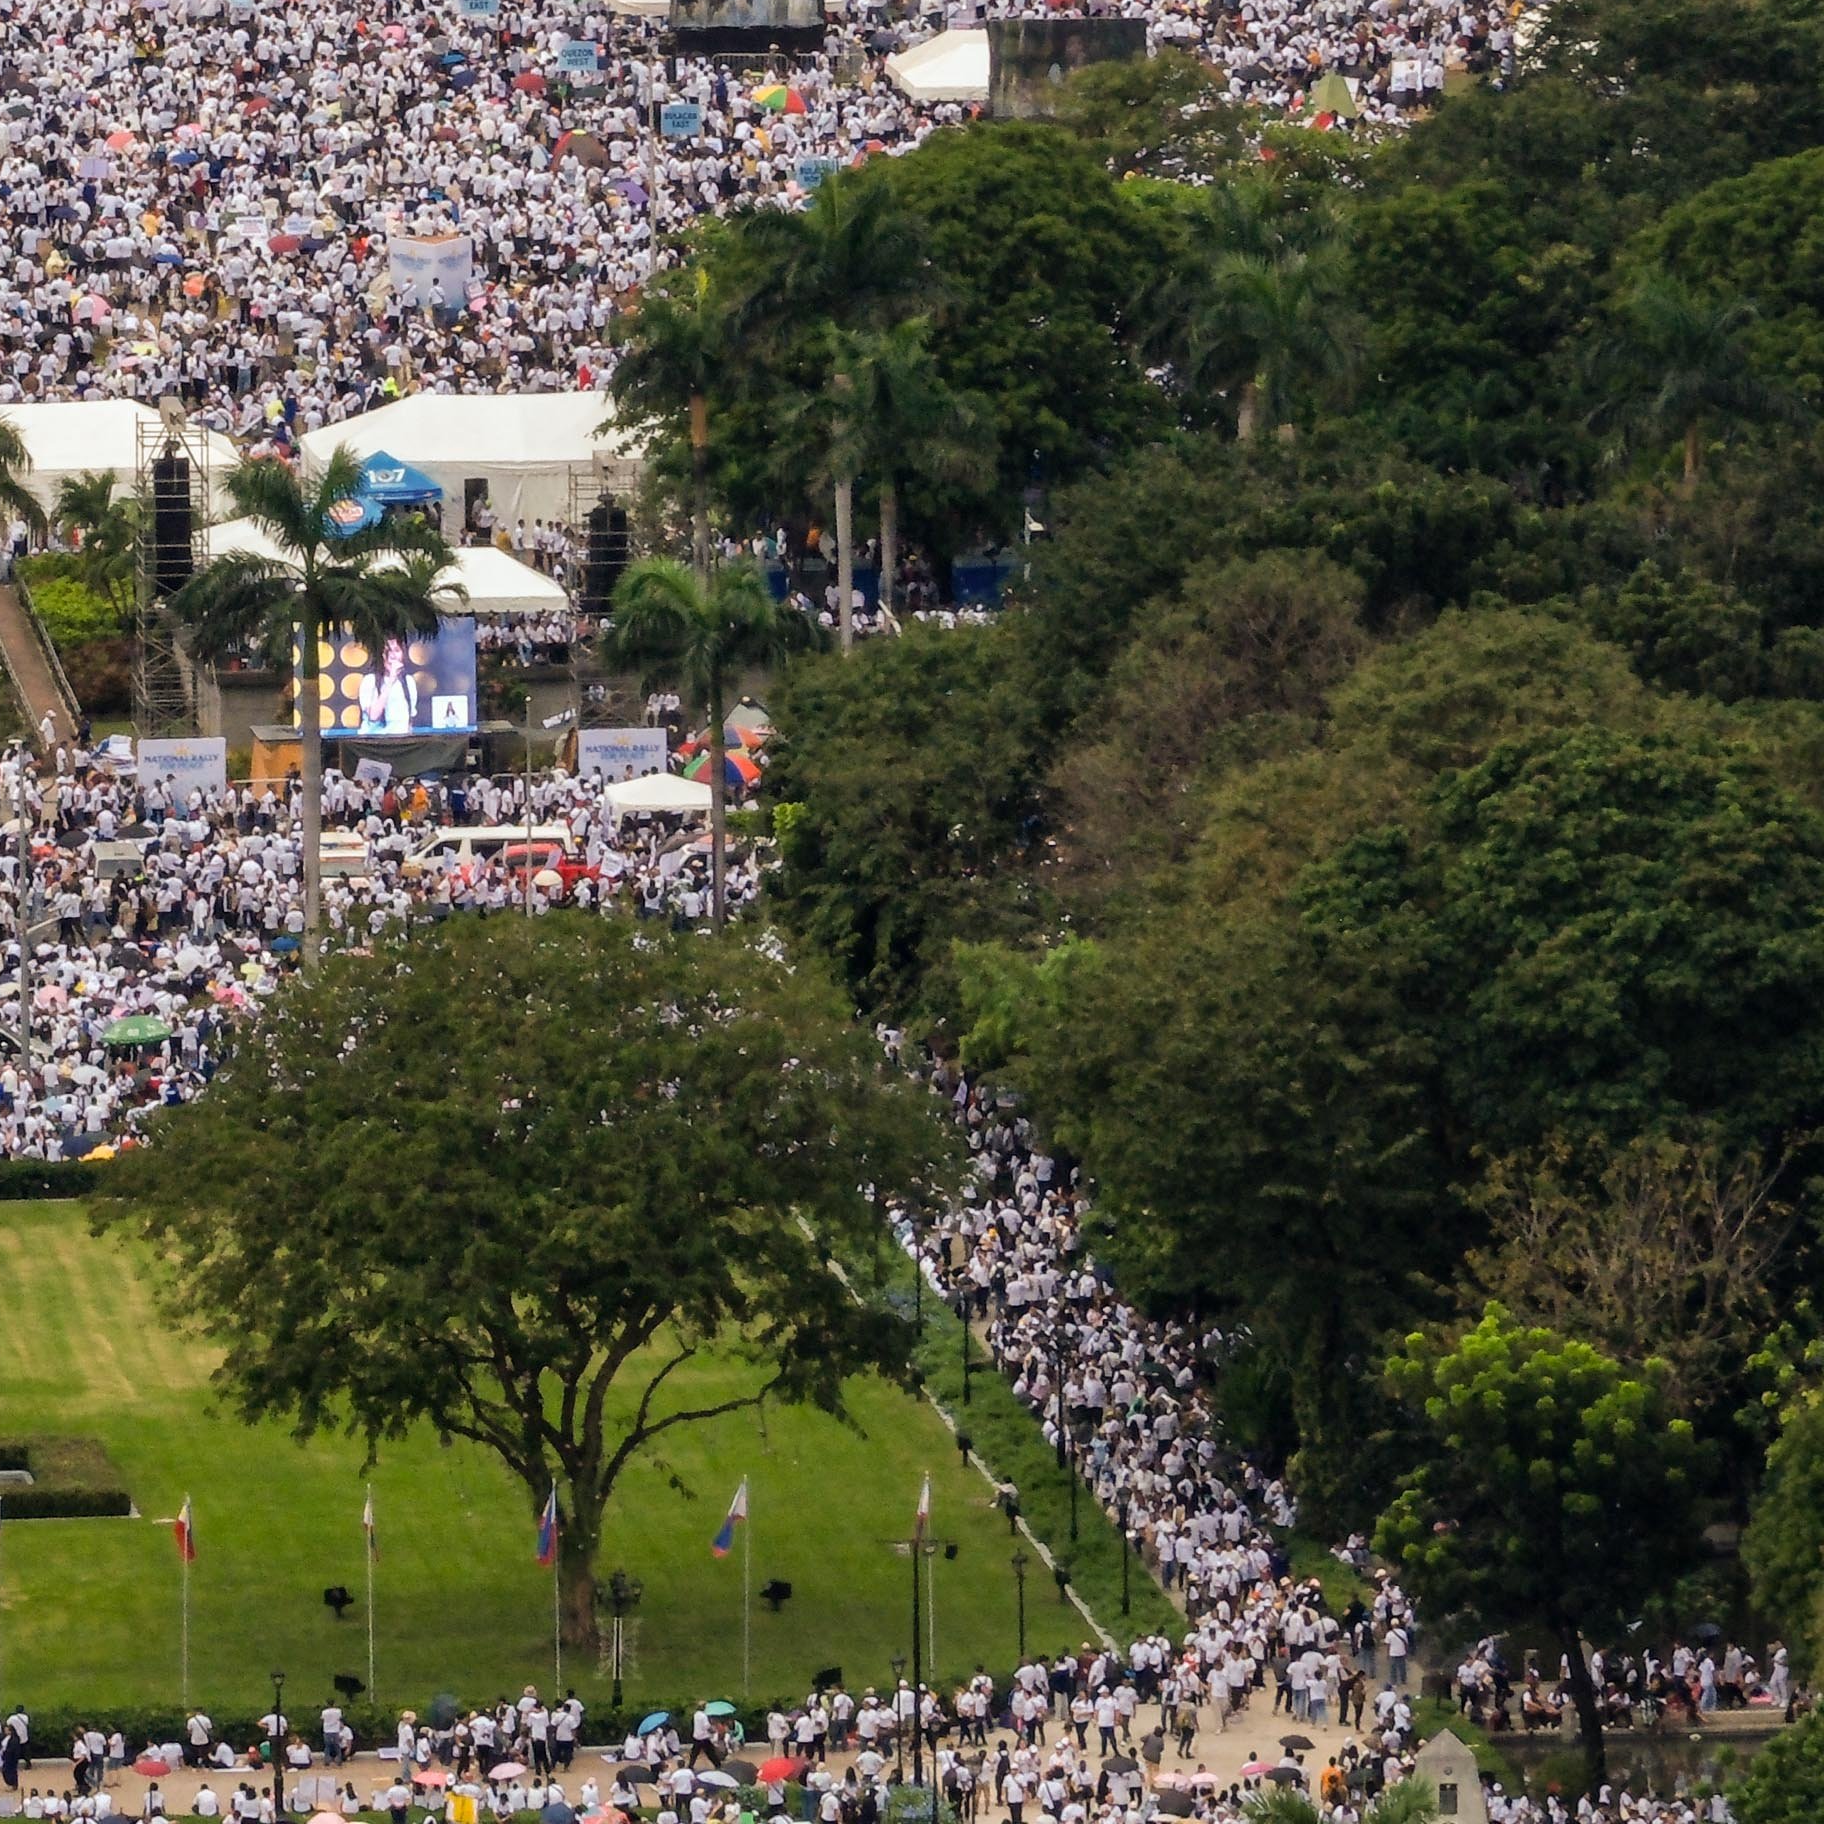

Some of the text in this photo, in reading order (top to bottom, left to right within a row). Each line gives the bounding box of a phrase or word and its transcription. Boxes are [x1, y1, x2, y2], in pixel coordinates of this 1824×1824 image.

[585, 744, 660, 753] NATIONAL RALLY
[144, 754, 219, 763] NATIONAL RALLY
